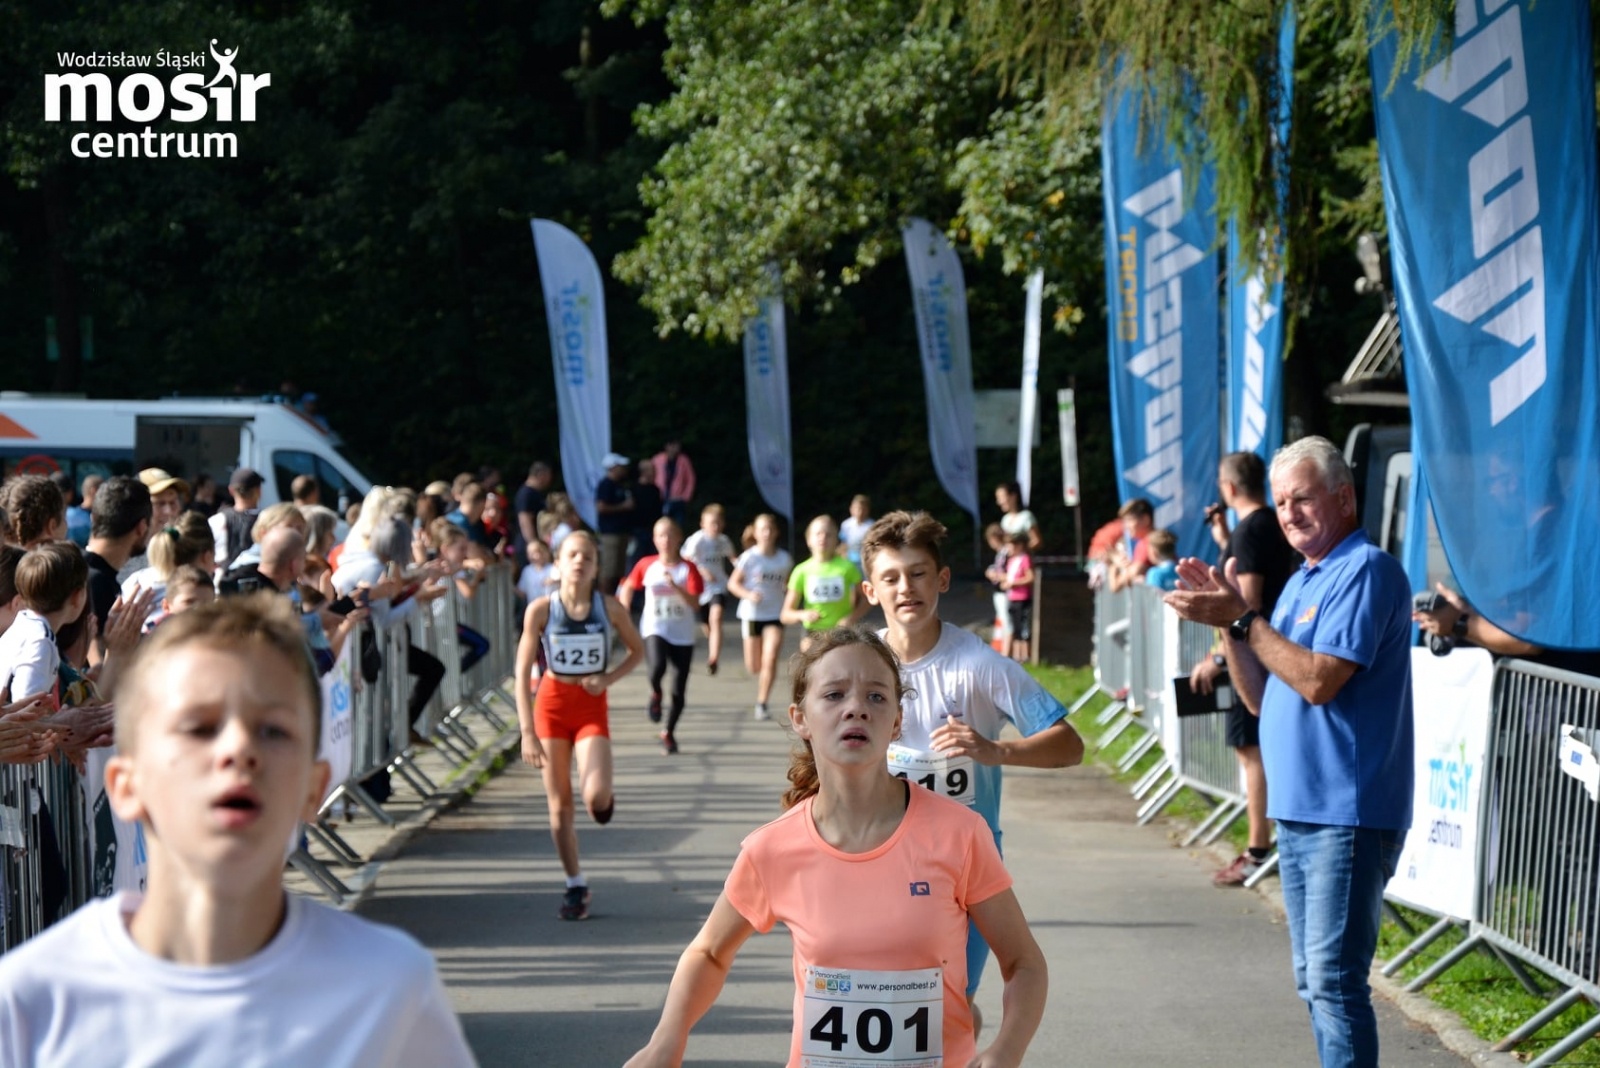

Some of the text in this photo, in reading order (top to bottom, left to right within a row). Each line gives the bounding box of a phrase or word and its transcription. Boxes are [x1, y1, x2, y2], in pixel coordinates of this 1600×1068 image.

[555, 648, 600, 667] 425
[815, 970, 851, 981] PersonalBest
[857, 980, 937, 992] www.personalbest.pl
[810, 1005, 928, 1054] 401
